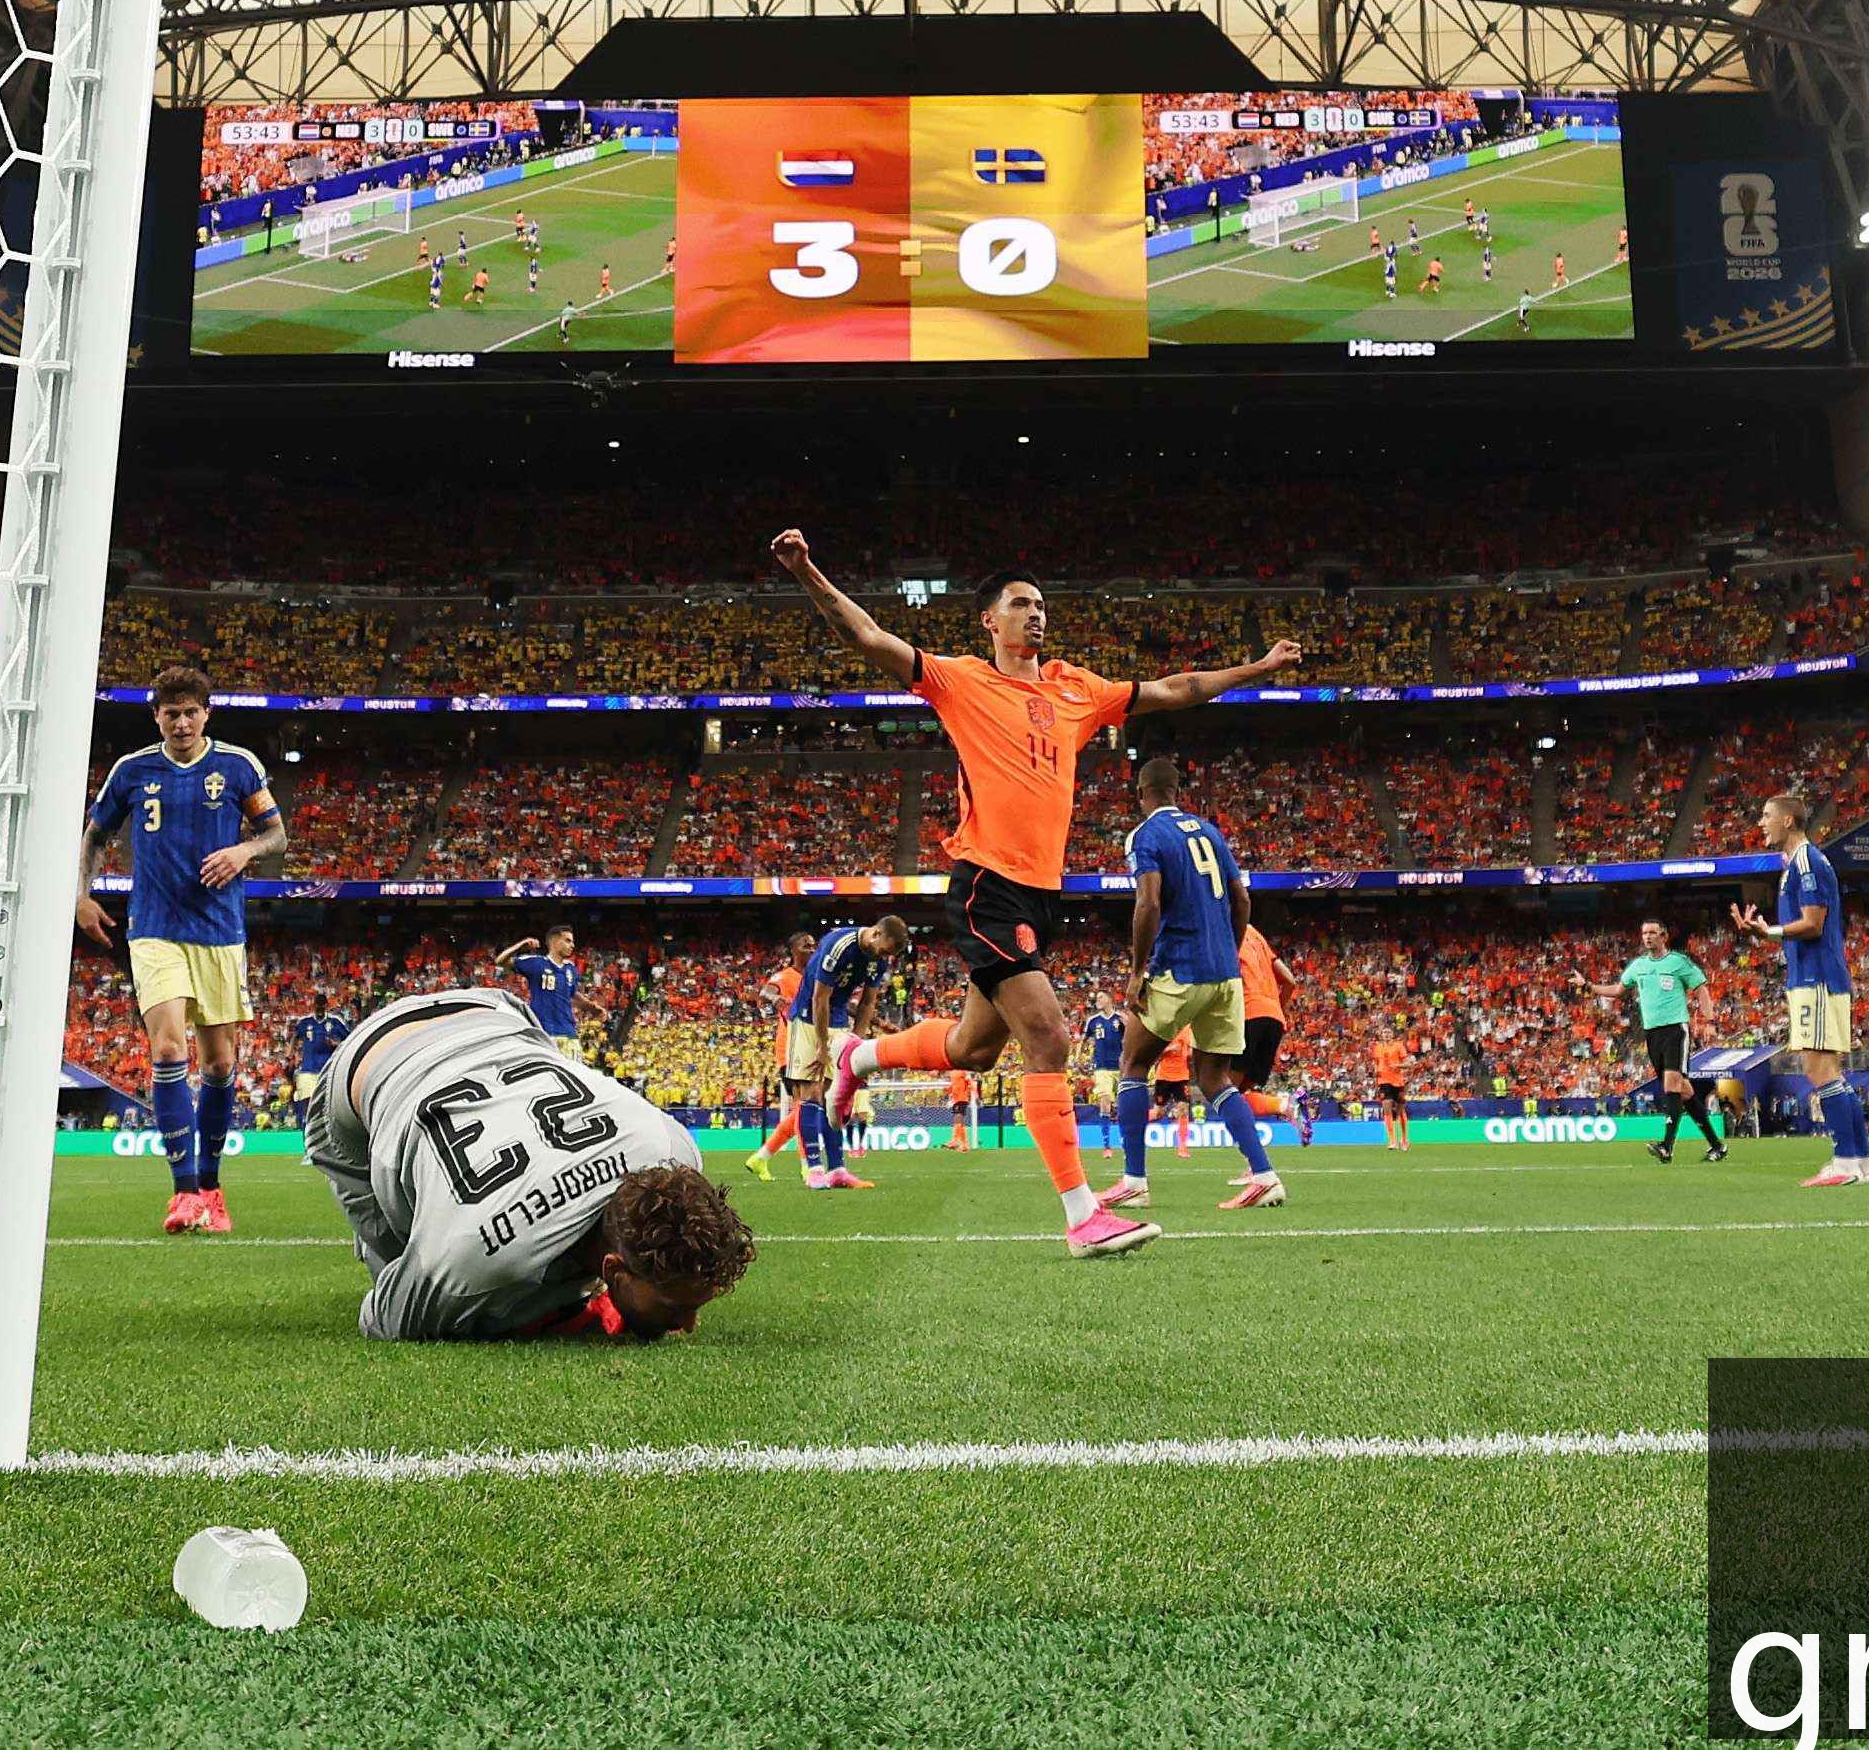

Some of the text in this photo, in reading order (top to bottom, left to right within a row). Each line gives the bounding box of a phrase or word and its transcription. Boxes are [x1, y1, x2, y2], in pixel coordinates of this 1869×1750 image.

[1171, 114, 1220, 129] 53:43
[1311, 113, 1320, 126] 3
[1350, 113, 1358, 126] 0
[232, 125, 280, 140] 53:43
[370, 125, 380, 138] 3
[409, 125, 418, 138] 0
[1380, 163, 1429, 190] aramco
[435, 174, 484, 201] aramco
[769, 221, 859, 299] 3
[958, 218, 1058, 297] 0
[1349, 339, 1436, 357] Hisense
[387, 351, 475, 368] Hisense
[1796, 657, 1848, 673] HOUSTON
[1432, 687, 1484, 698] HOUSTON
[1578, 680, 1603, 691] FIFA
[1602, 677, 1641, 690] WORLD
[1641, 676, 1662, 687] CUP
[363, 700, 417, 710] HOUSTON
[719, 697, 772, 707] HOUSTON
[1026, 732, 1058, 775] 14
[144, 798, 161, 833] 3
[1186, 836, 1225, 900] 4
[1398, 872, 1464, 884] HOUSTON
[380, 884, 446, 895] HOUSTON
[1800, 1005, 1810, 1025] 2
[415, 1061, 620, 1205] 23
[1144, 1122, 1272, 1147] aramo
[1484, 1117, 1617, 1142] aramco
